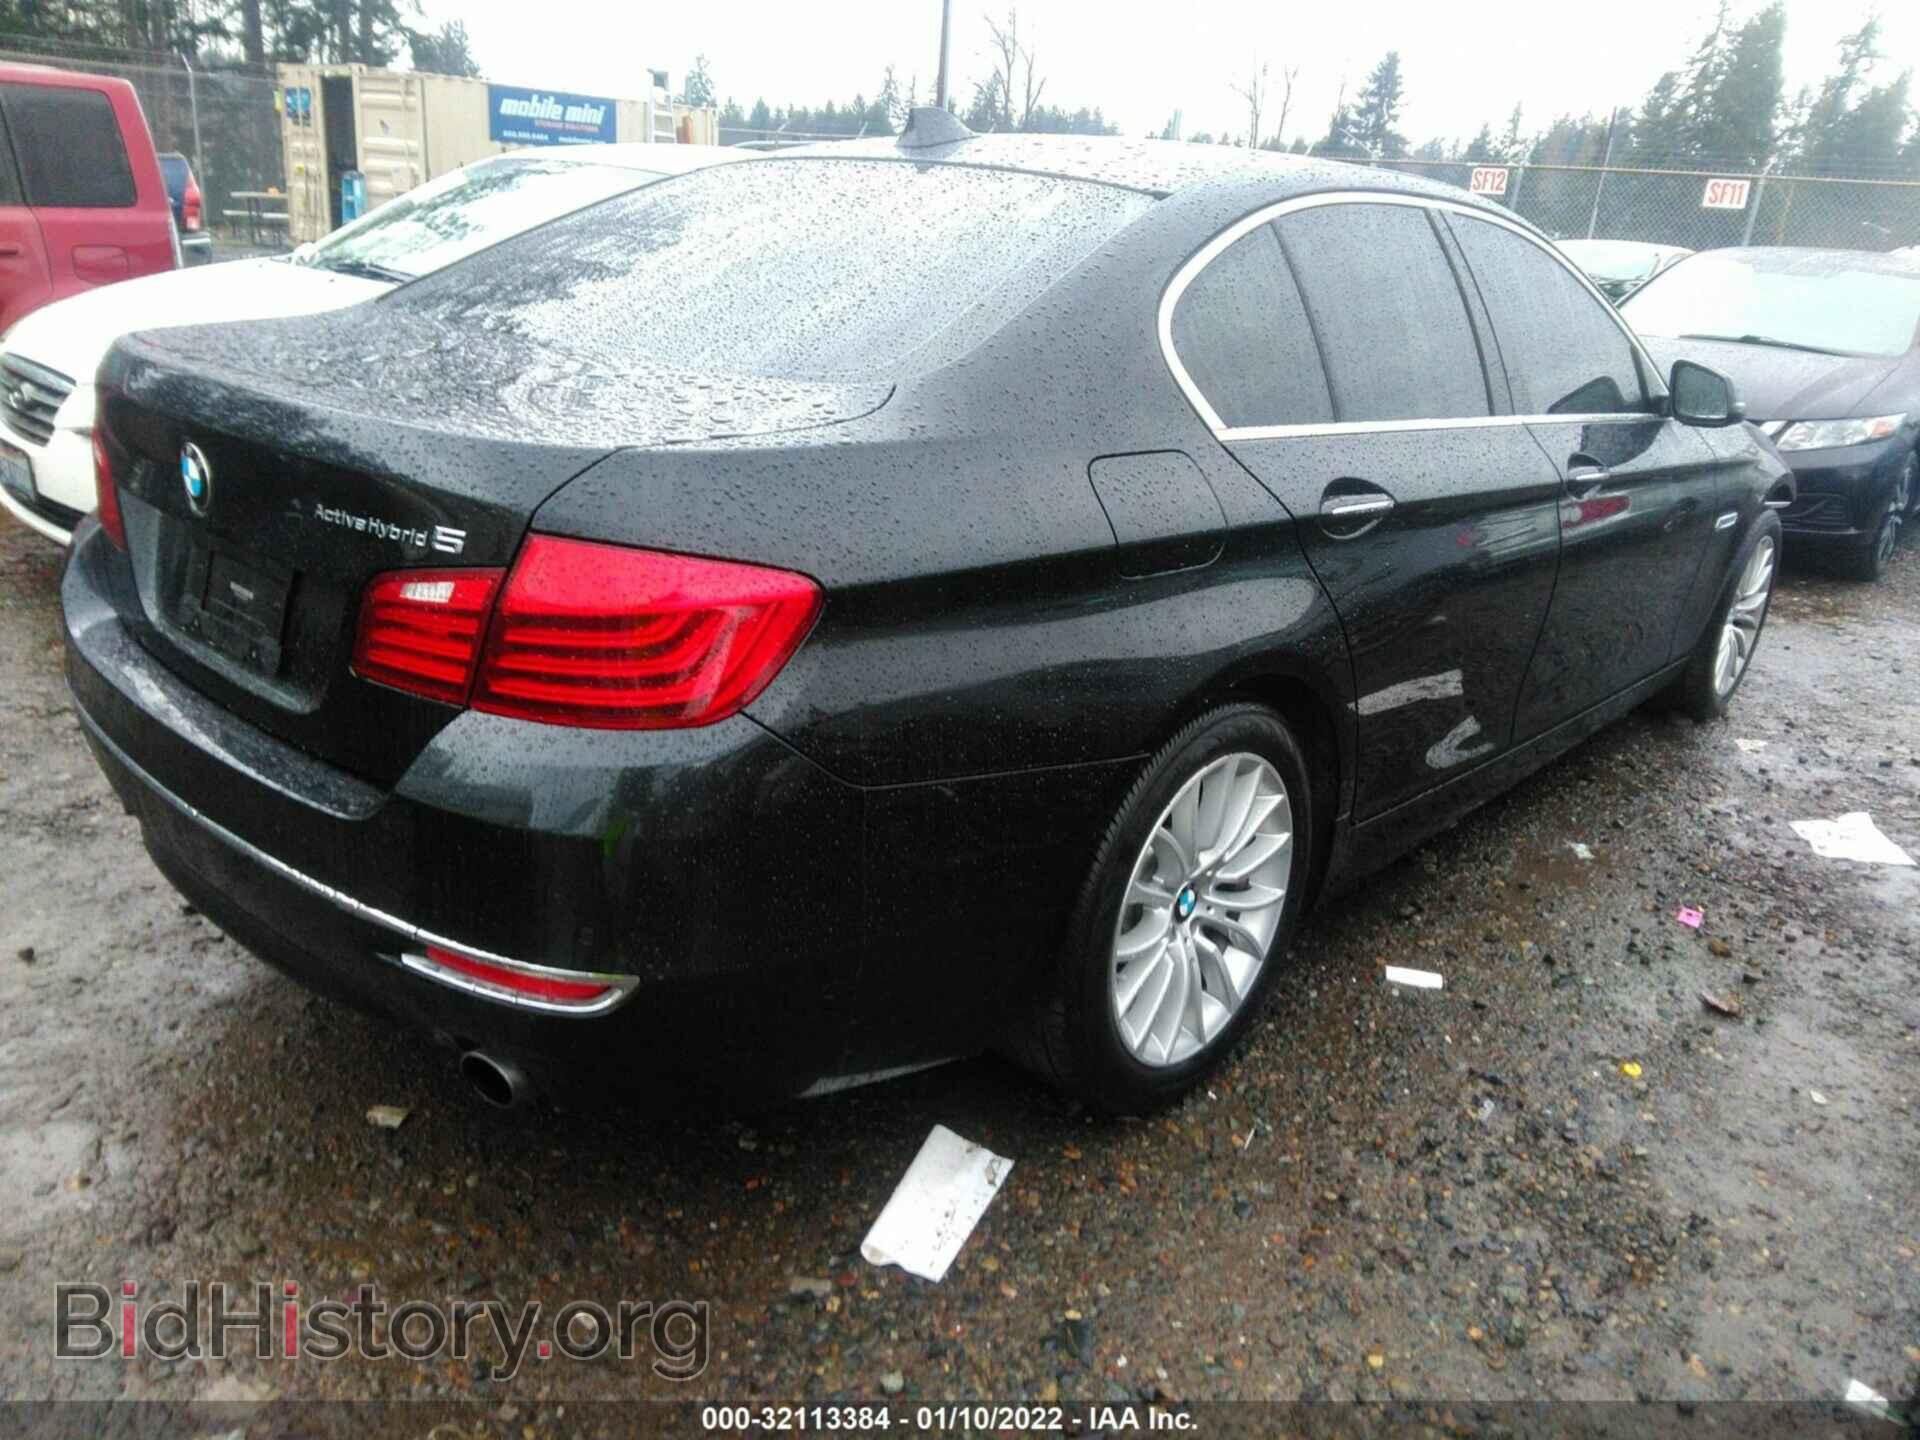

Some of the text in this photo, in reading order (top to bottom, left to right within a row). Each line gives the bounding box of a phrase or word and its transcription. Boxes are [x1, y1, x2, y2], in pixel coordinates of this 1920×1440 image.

[499, 93, 606, 125] mobile mini
[1471, 169, 1506, 192] SF12
[1707, 181, 1746, 205] SF11
[314, 503, 467, 554] ActiveHybrid 5
